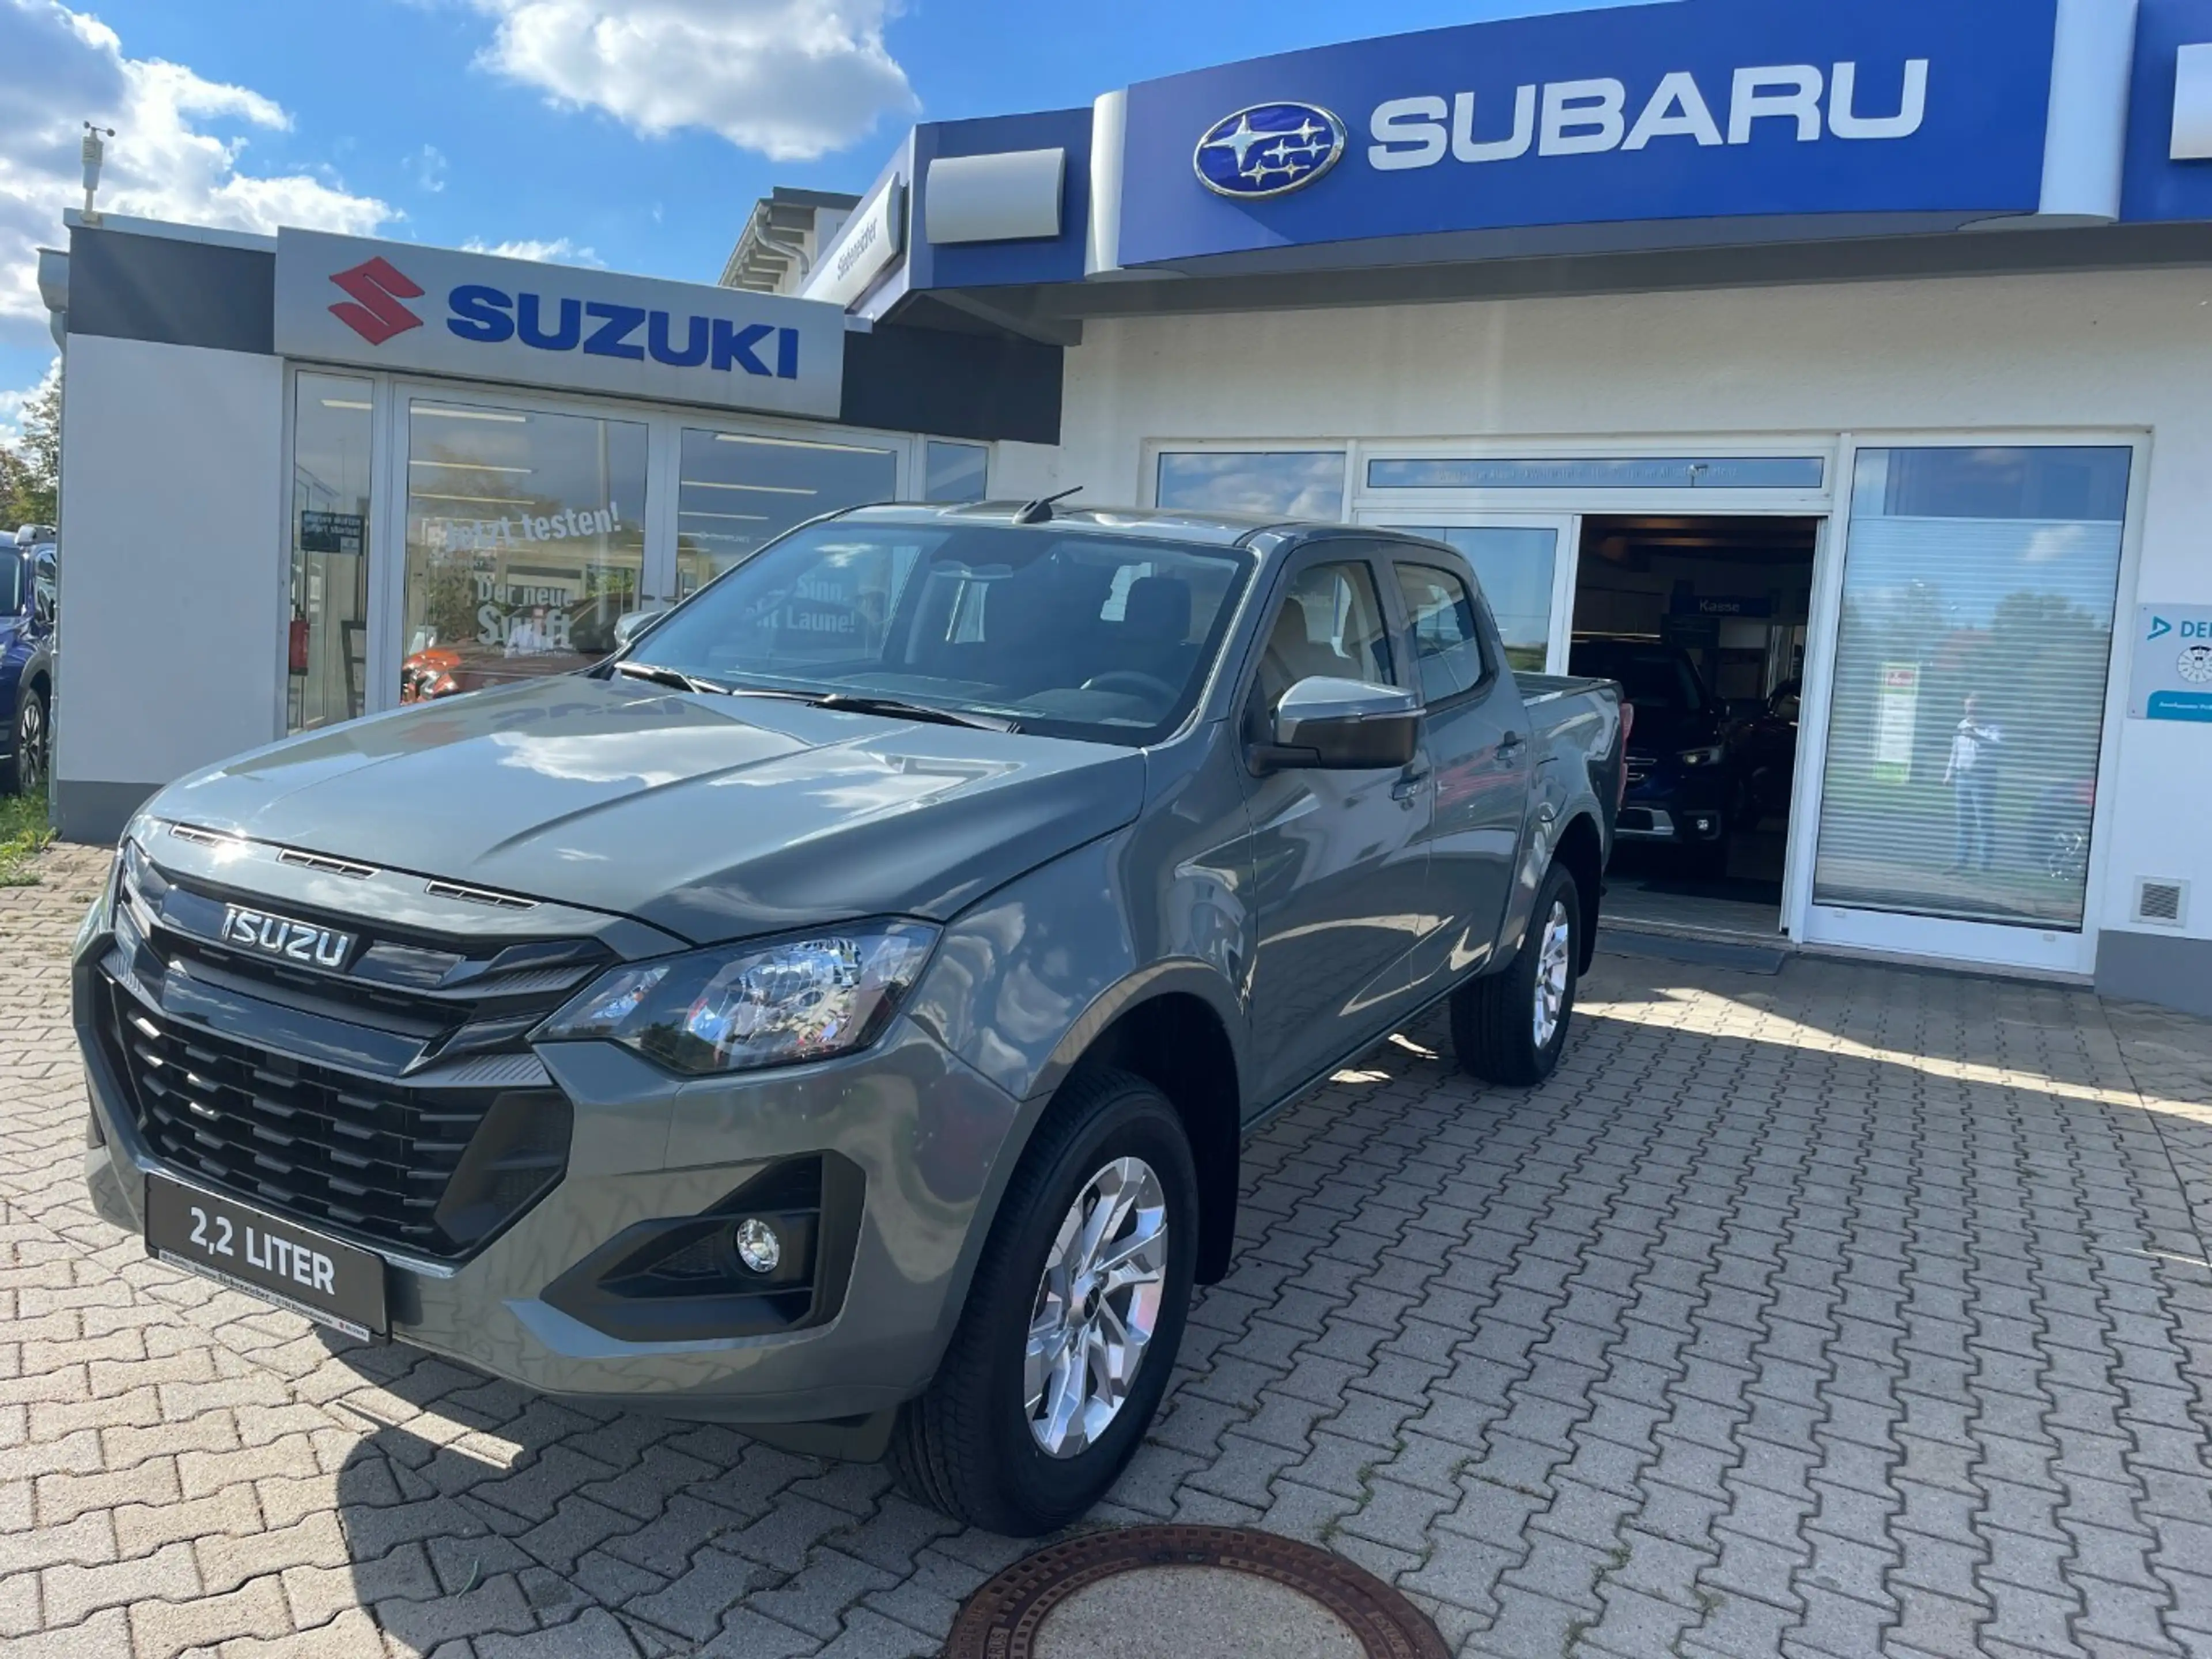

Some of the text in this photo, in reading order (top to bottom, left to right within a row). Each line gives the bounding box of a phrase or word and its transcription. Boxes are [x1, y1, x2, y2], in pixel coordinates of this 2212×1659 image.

[1368, 58, 1929, 171] SUBARU
[447, 284, 799, 380] SUZUKI
[522, 502, 621, 542] testen!
[475, 575, 574, 607] Der neue
[1699, 599, 1740, 613] Kasse
[477, 601, 573, 649] Swift
[787, 605, 855, 633] Laune!
[2180, 620, 2212, 638] DE
[222, 908, 348, 967] ISUZU
[190, 1207, 335, 1296] 2,2 LITER
